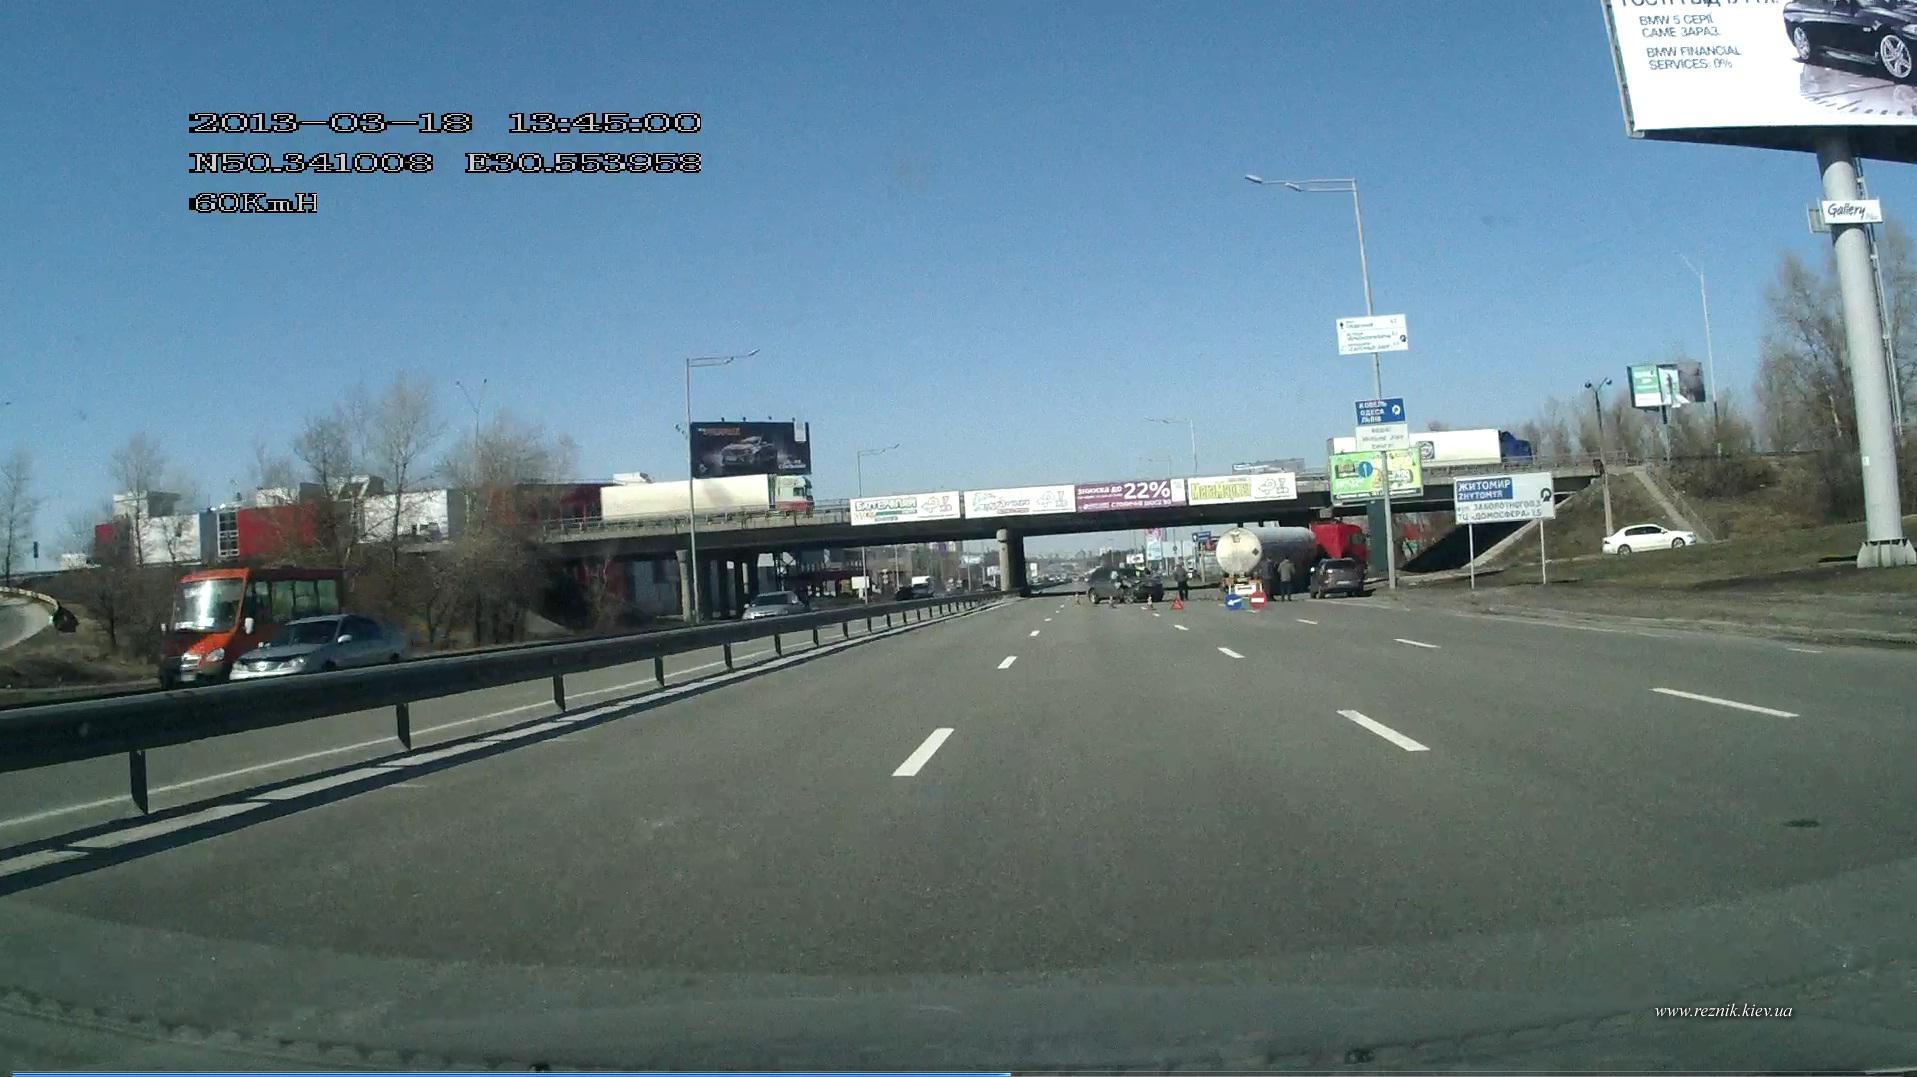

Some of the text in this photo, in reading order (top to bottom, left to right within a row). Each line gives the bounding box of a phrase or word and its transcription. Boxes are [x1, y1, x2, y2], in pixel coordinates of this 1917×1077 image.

[1639, 15, 1669, 26] BMW
[1673, 15, 1681, 25] 5
[1642, 27, 1677, 38] САМЕ
[1646, 45, 1742, 58] BMW FINANCIAL
[1828, 203, 1866, 219] Gallery
[1123, 481, 1171, 500] 22%
[1458, 479, 1511, 491] ЖИТОМИР
